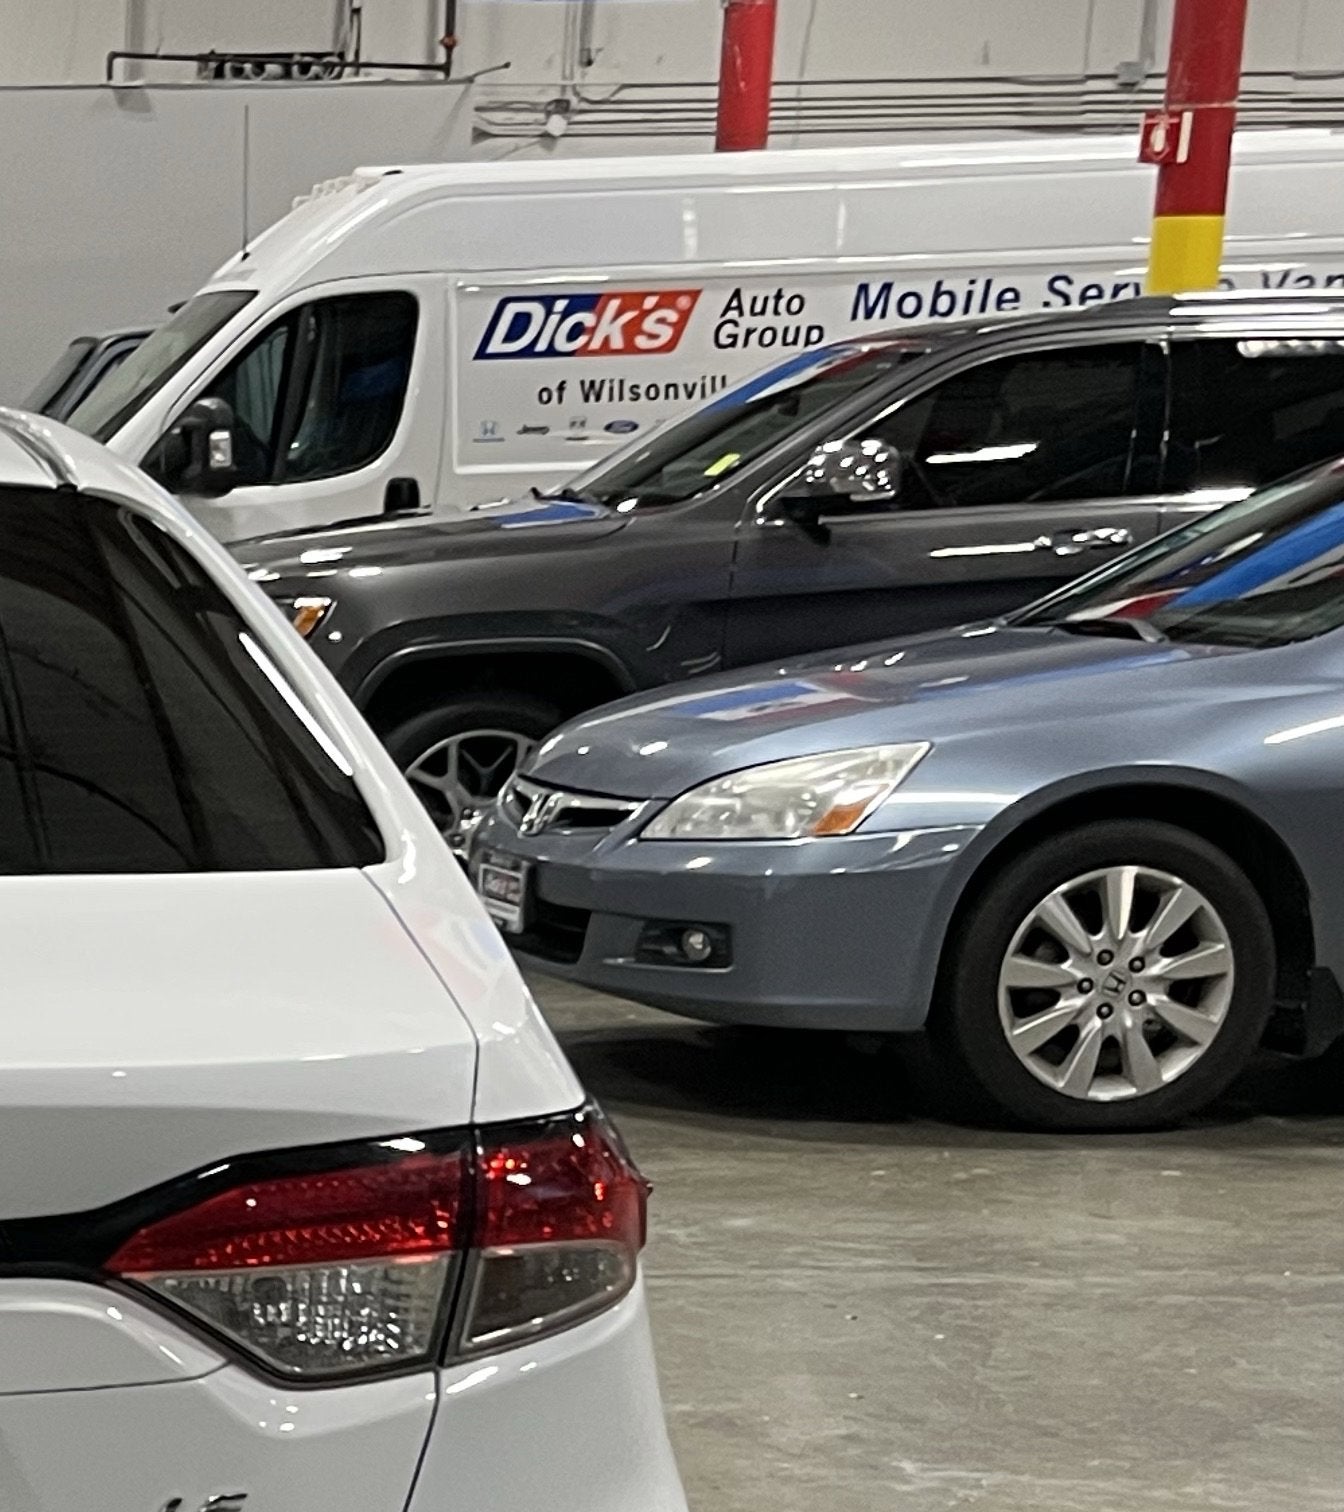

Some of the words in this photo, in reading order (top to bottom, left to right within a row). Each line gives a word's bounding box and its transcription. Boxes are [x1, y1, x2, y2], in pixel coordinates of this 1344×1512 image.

[720, 288, 805, 318] Auto
[850, 278, 1022, 321] Mobile
[713, 319, 825, 350] Group
[538, 380, 567, 405] of
[580, 375, 727, 404] Wilsonvill
